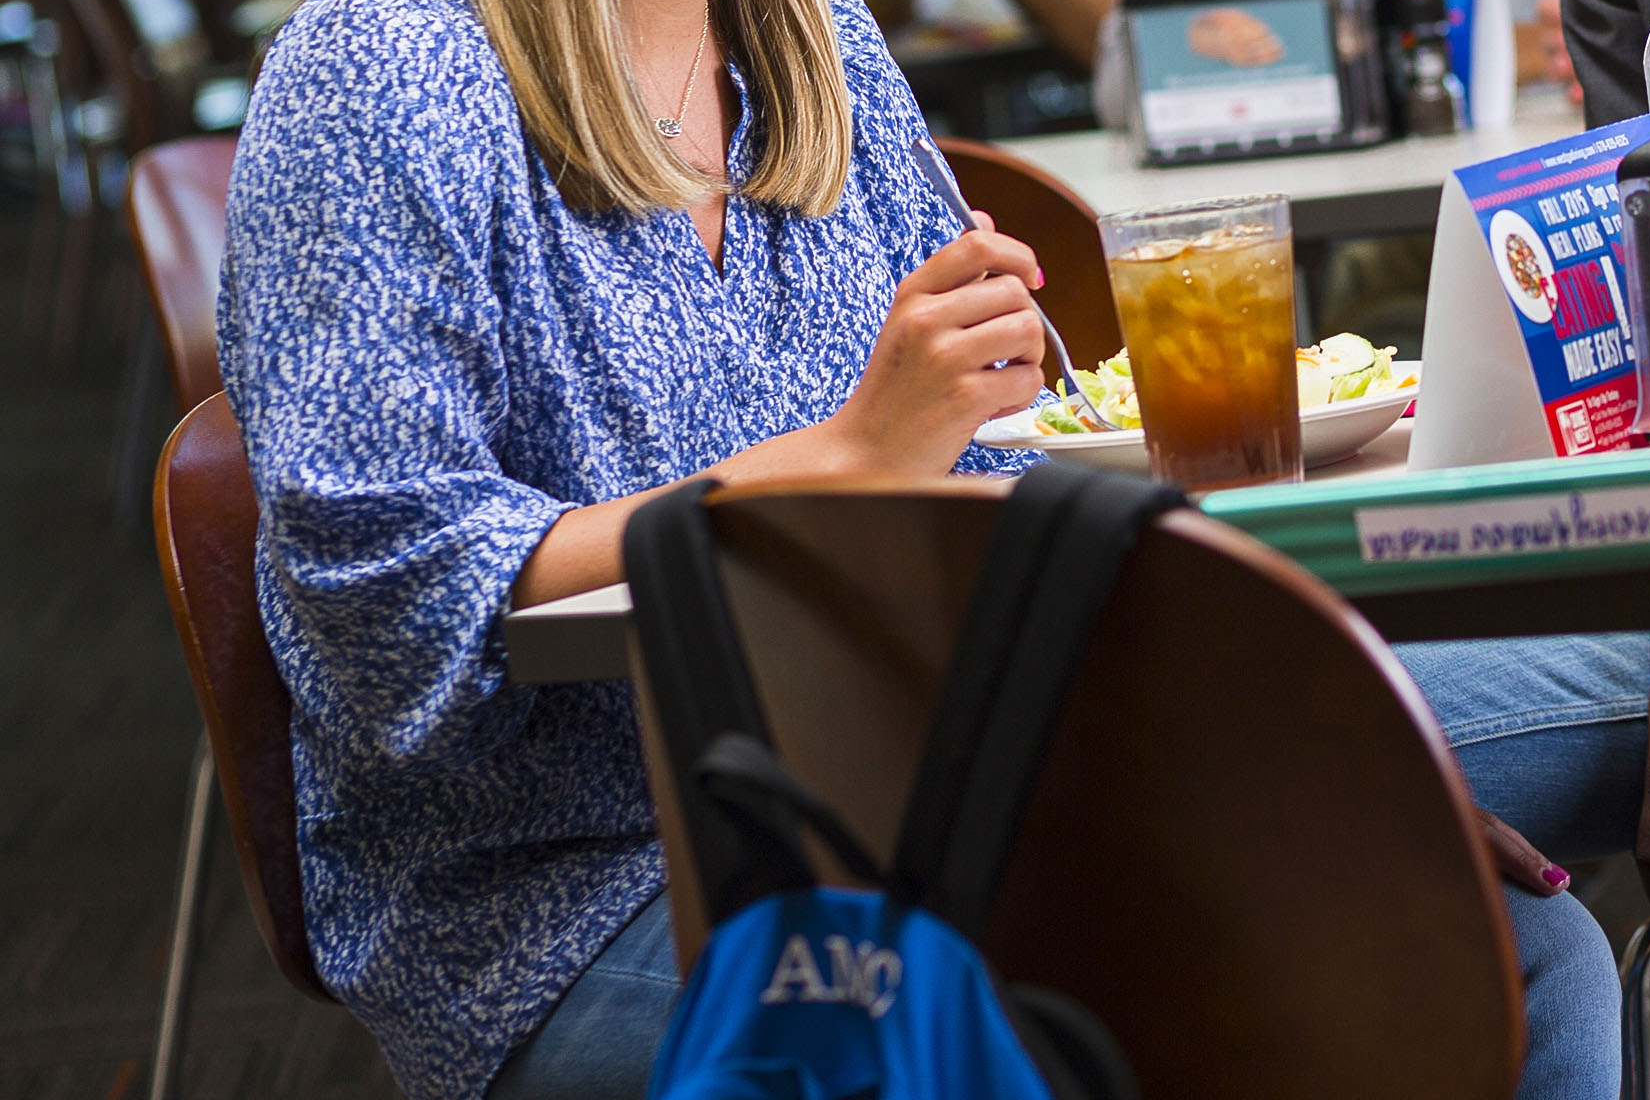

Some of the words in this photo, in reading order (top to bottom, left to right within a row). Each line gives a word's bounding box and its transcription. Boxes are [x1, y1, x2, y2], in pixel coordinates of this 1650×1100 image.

[1537, 195, 1567, 227] FALL
[1546, 229, 1578, 261] MEAL
[1570, 221, 1605, 254] PLANS
[1562, 336, 1598, 384] MADE
[1592, 326, 1625, 372] EASY
